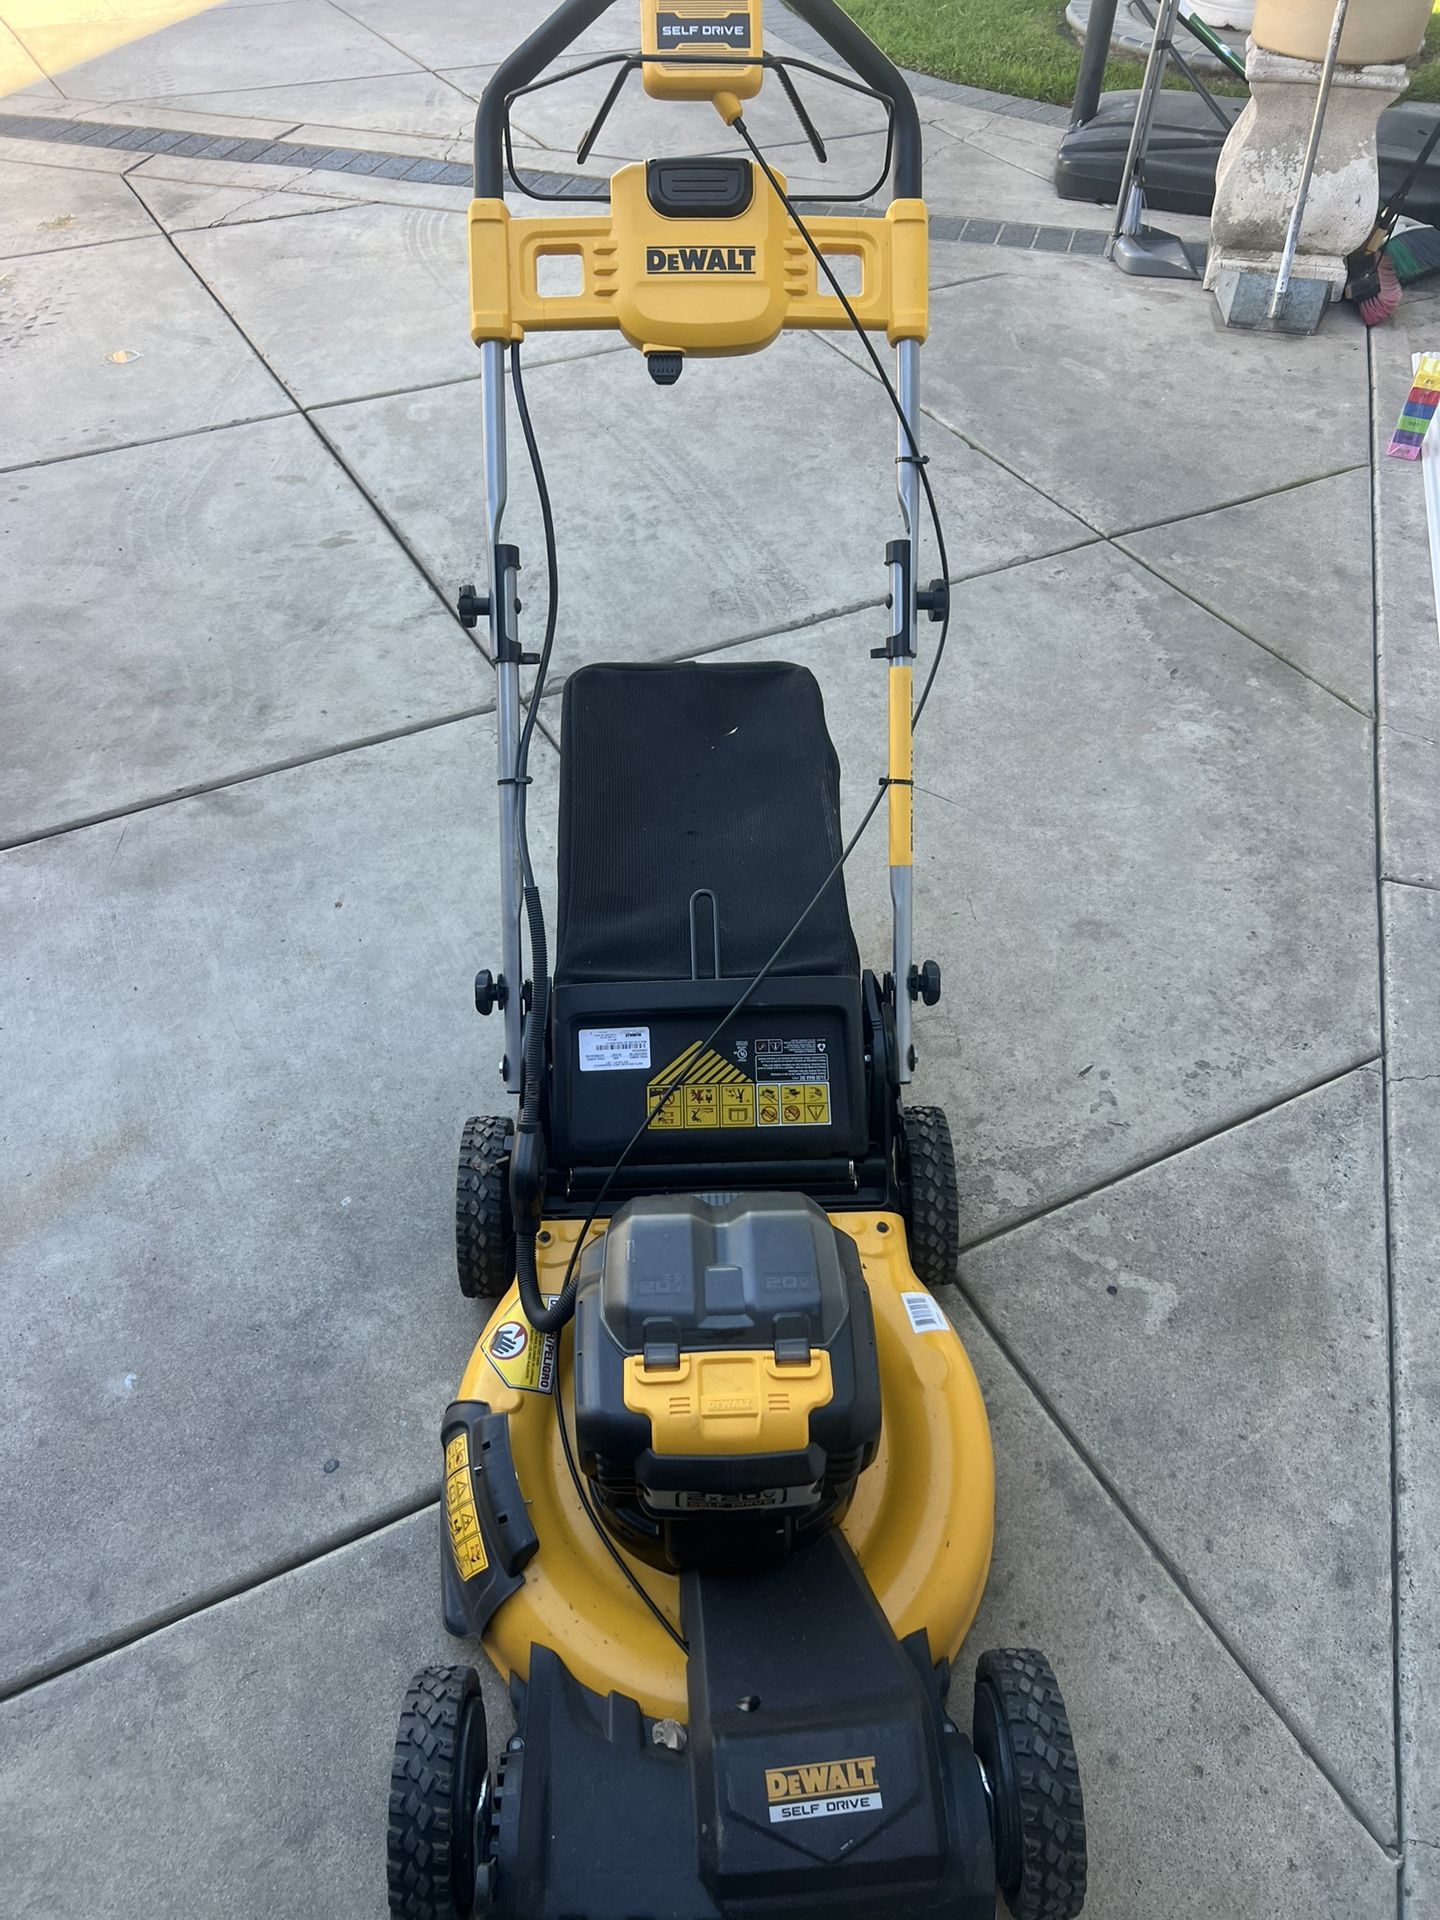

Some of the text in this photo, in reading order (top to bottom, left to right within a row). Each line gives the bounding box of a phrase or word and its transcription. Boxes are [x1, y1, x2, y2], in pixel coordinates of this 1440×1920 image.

[662, 25, 744, 36] SELF DRIVE
[646, 249, 756, 272] DEWALT
[765, 1760, 877, 1798] DEWALT
[781, 1796, 870, 1818] SELF DRIVE
